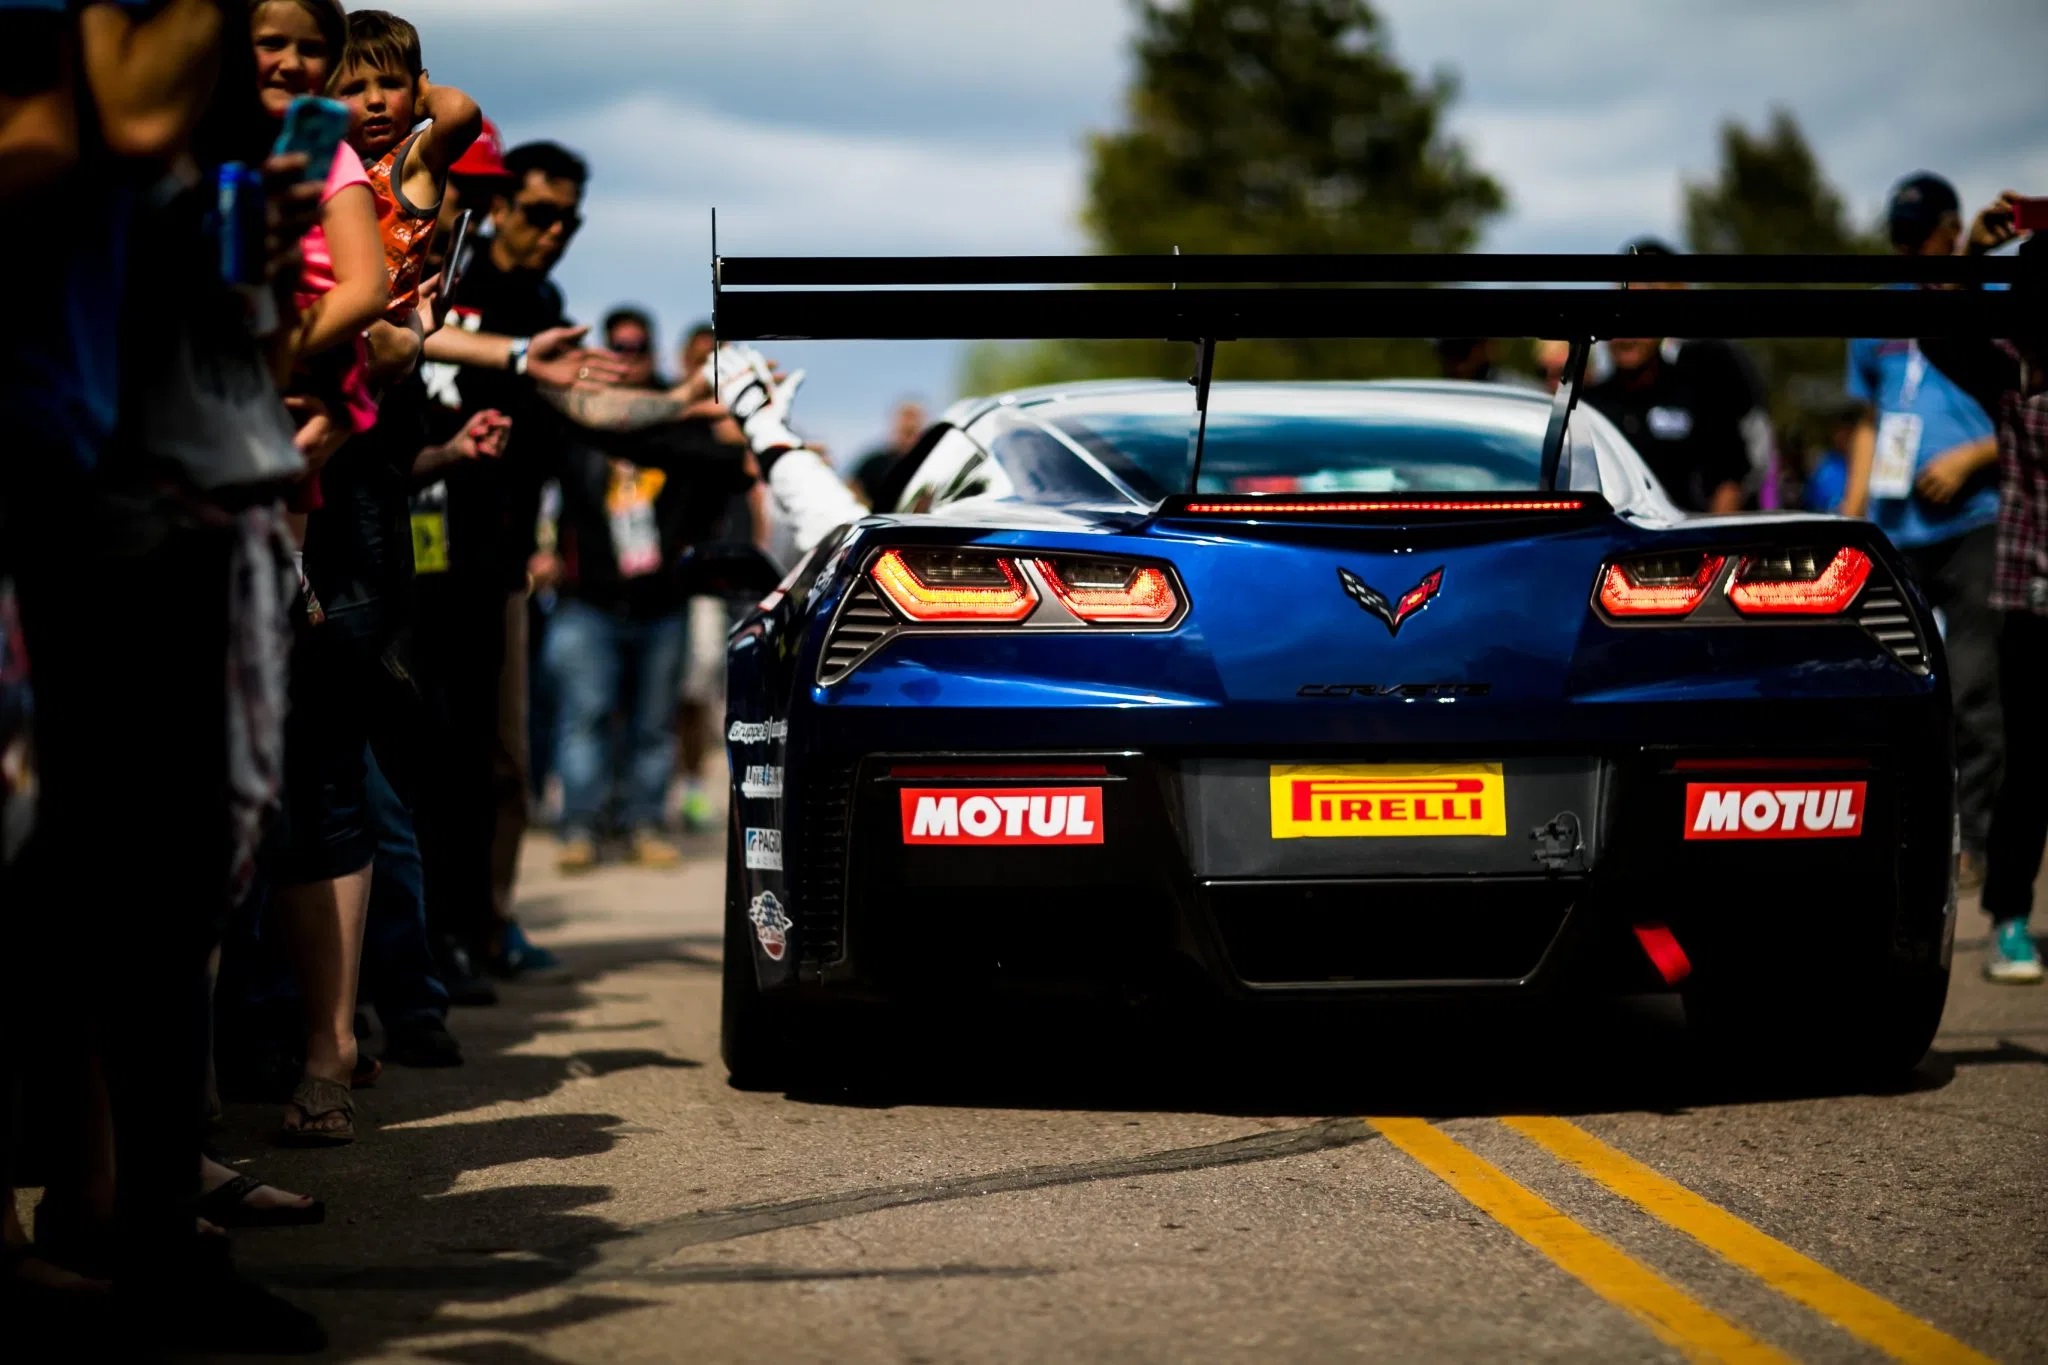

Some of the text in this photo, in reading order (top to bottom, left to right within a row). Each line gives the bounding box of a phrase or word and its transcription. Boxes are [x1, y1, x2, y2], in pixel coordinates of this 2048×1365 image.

[1296, 683, 1492, 698] CORVETTE
[911, 795, 1095, 837] MOTUL
[1291, 779, 1484, 822] PIRELLI
[1693, 789, 1857, 832] MOTUL
